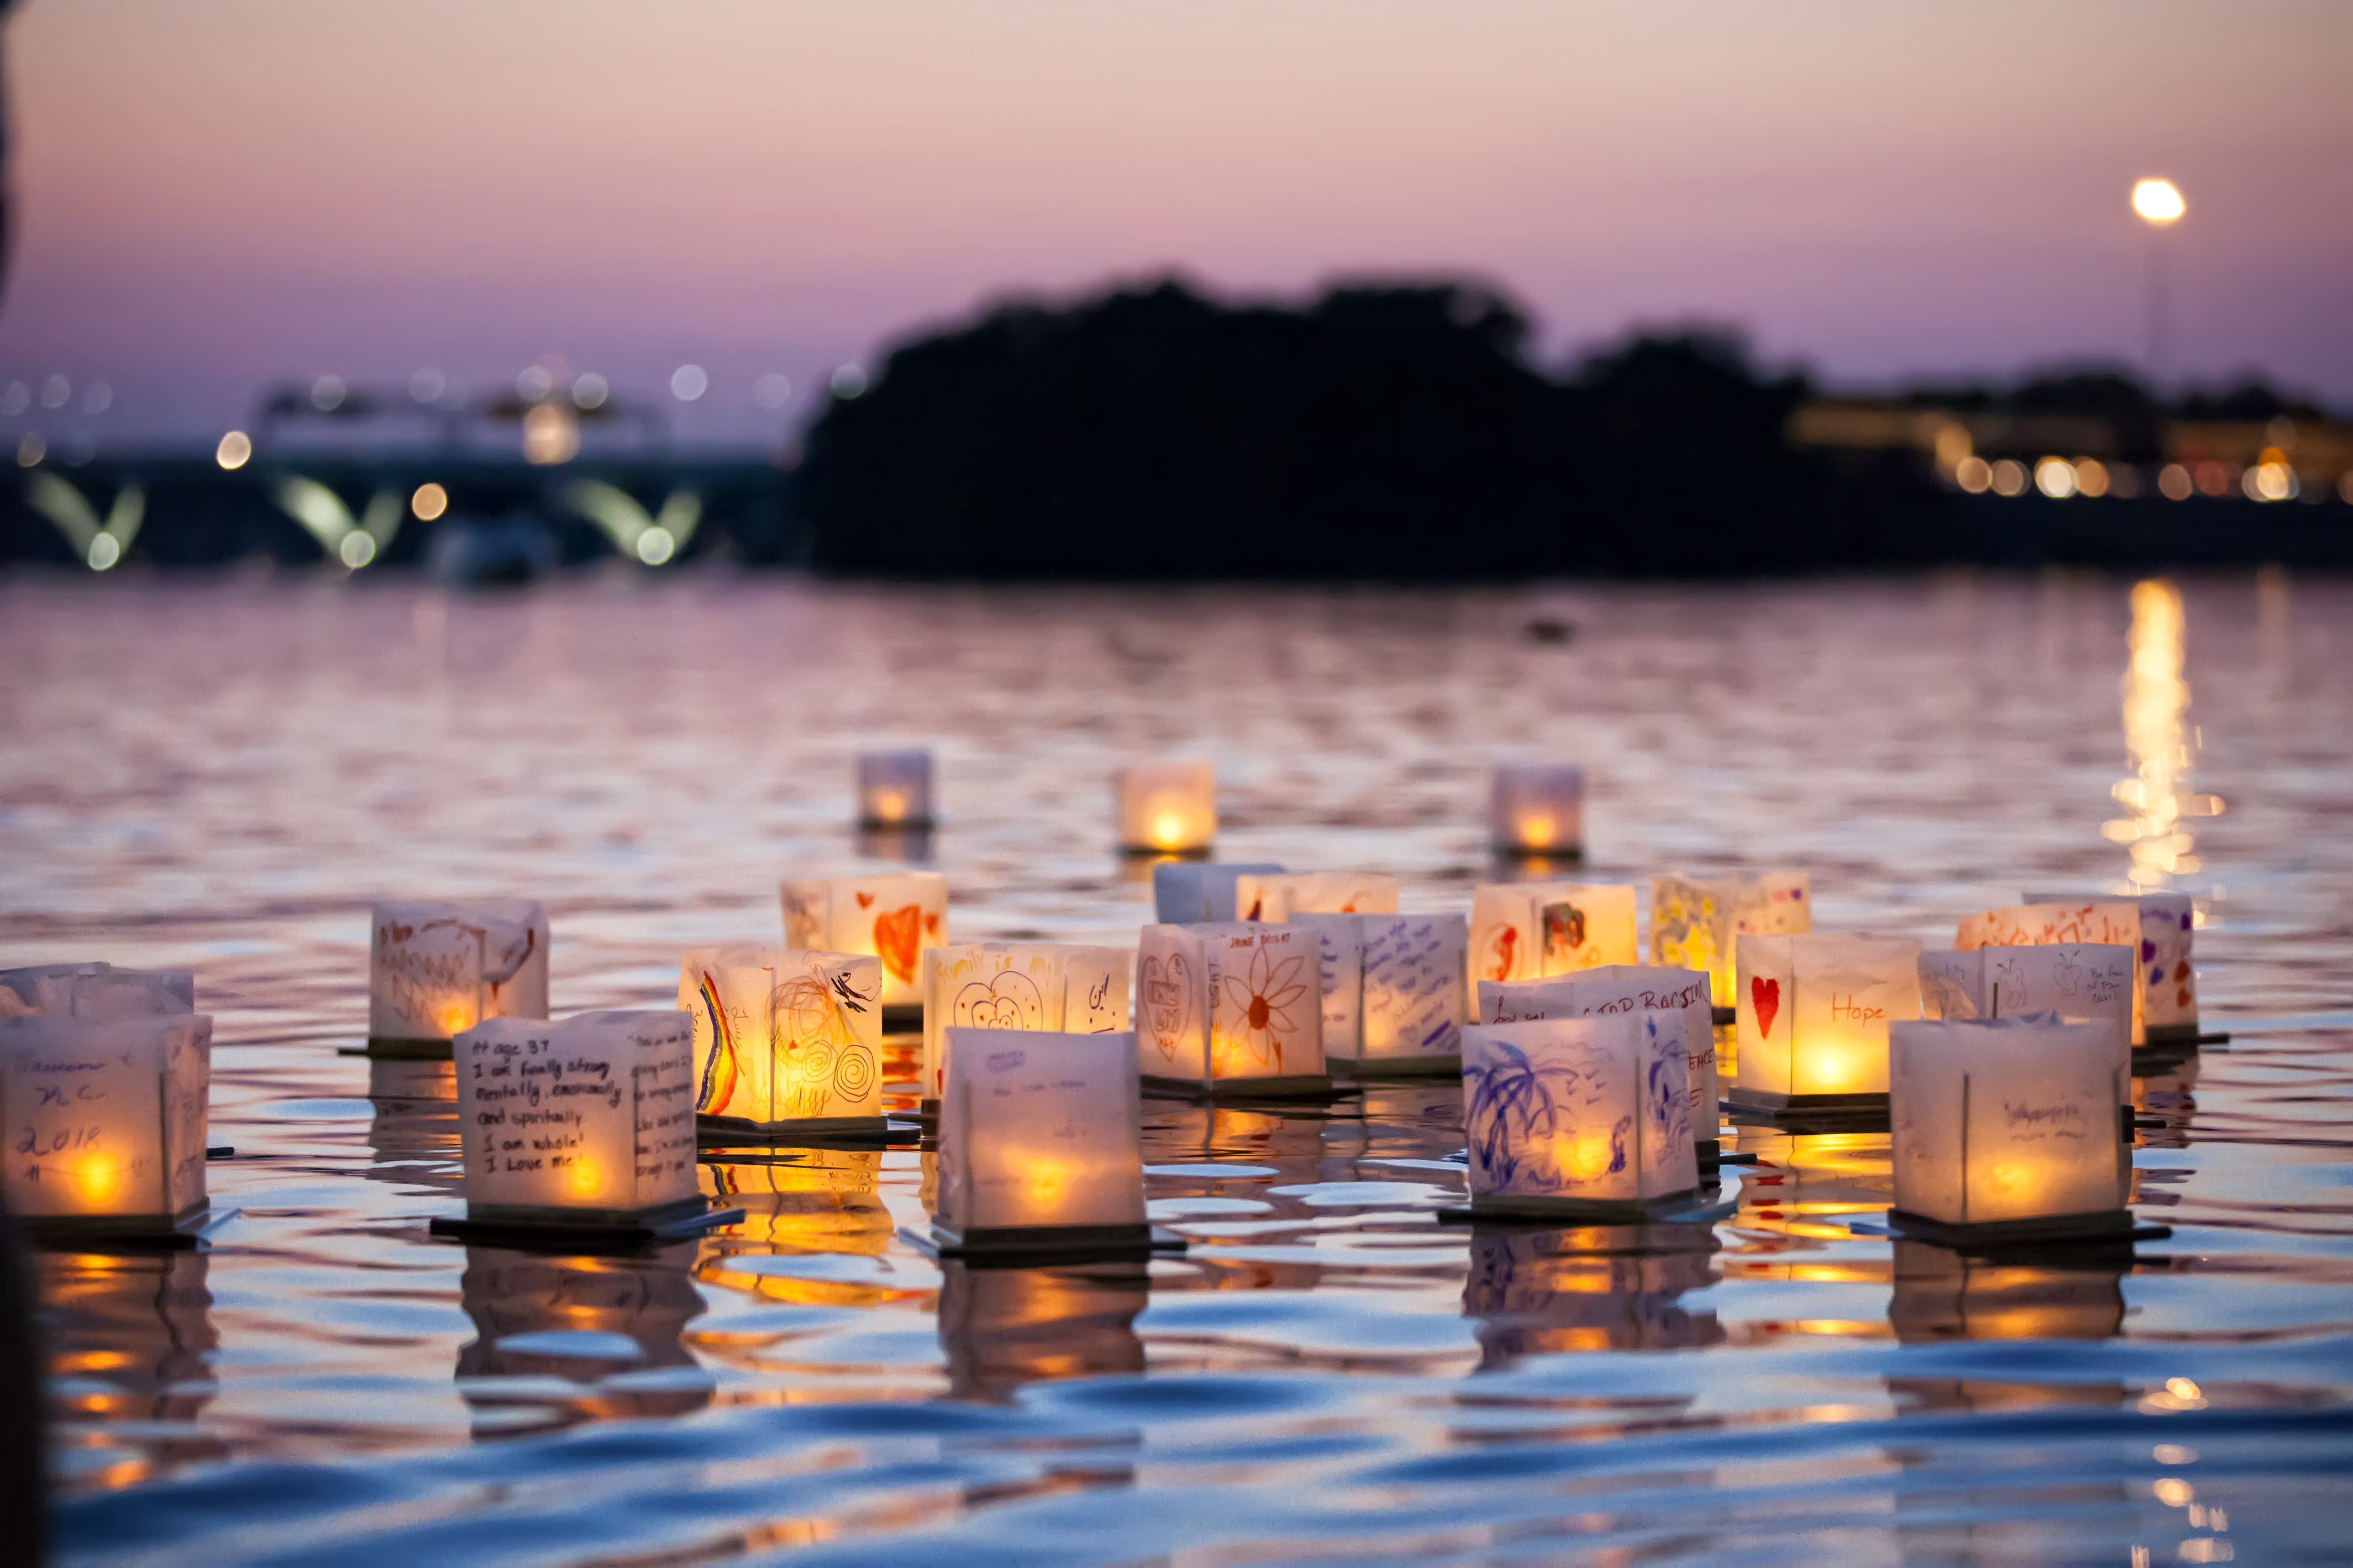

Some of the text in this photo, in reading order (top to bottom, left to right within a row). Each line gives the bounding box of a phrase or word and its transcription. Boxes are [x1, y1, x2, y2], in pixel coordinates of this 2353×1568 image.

[1833, 992, 1886, 1027] Hope
[494, 1043, 521, 1064] age
[1688, 1048, 1714, 1070] EACE
[473, 1063, 483, 1079] I
[520, 1060, 562, 1081] finally
[477, 1107, 506, 1126] and
[17, 1127, 102, 1157] 2018
[484, 1132, 495, 1153] I
[485, 1156, 496, 1173] I
